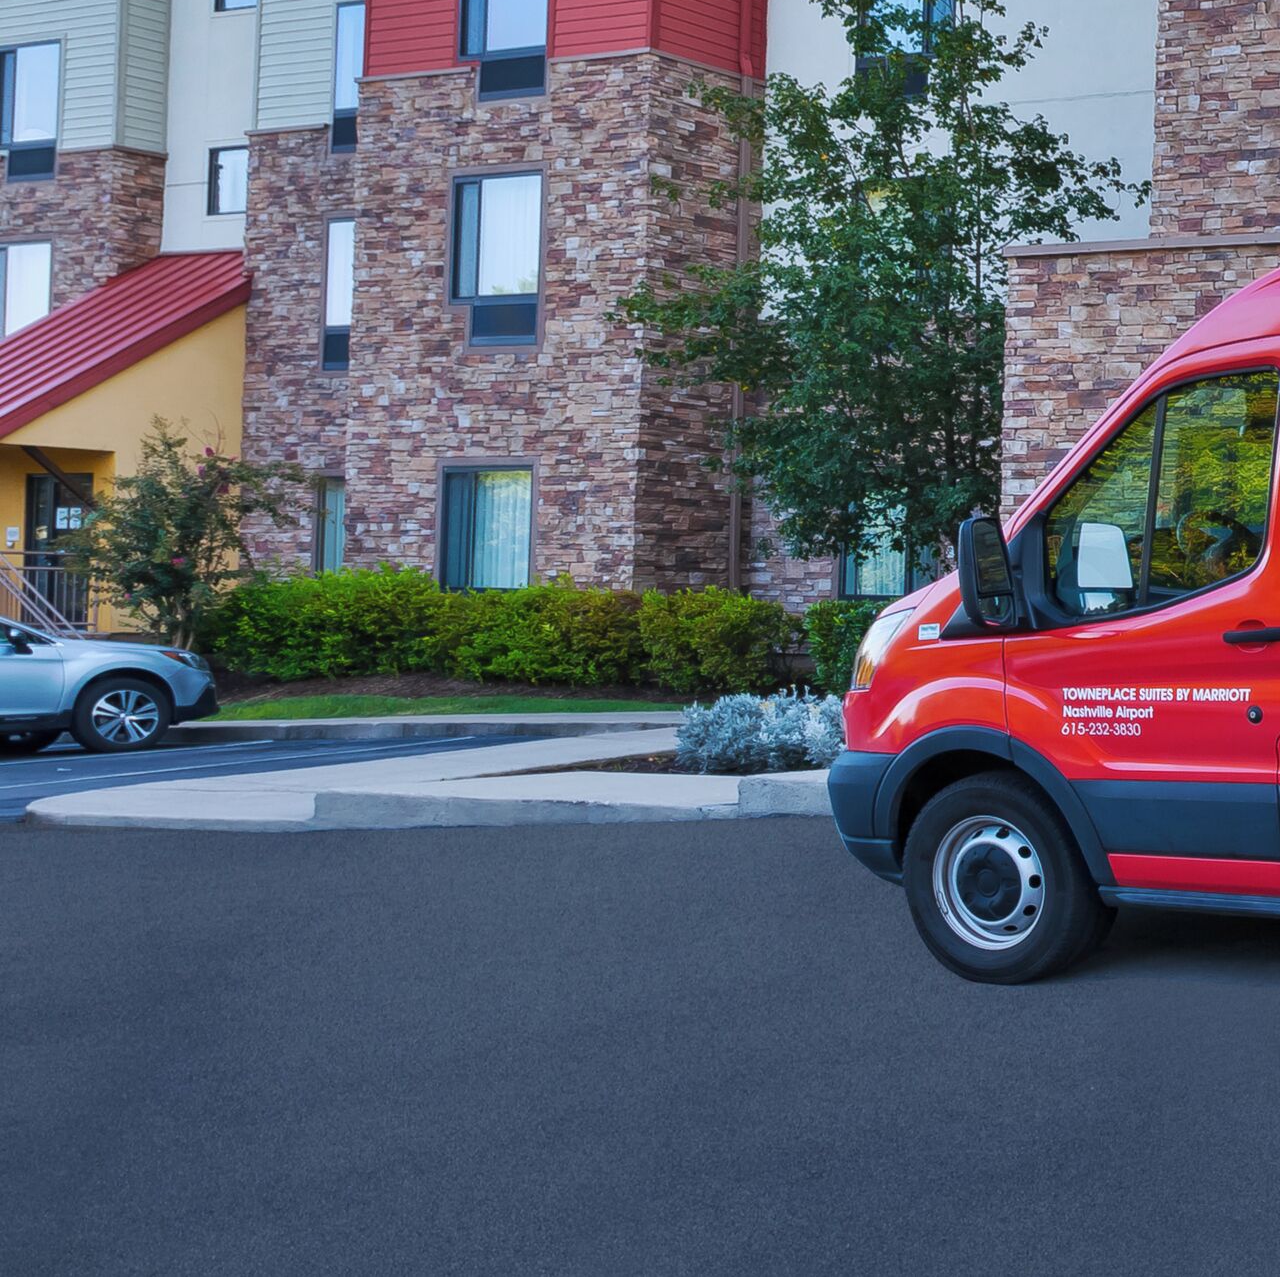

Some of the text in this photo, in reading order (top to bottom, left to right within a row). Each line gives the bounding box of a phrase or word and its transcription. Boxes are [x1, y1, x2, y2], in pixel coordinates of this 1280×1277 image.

[1062, 687, 1251, 701] TOWNEPLACE SUITES BY MARRIOTT
[1062, 705, 1154, 721] Nashville Airport
[1061, 722, 1141, 736] 615-232-3830
